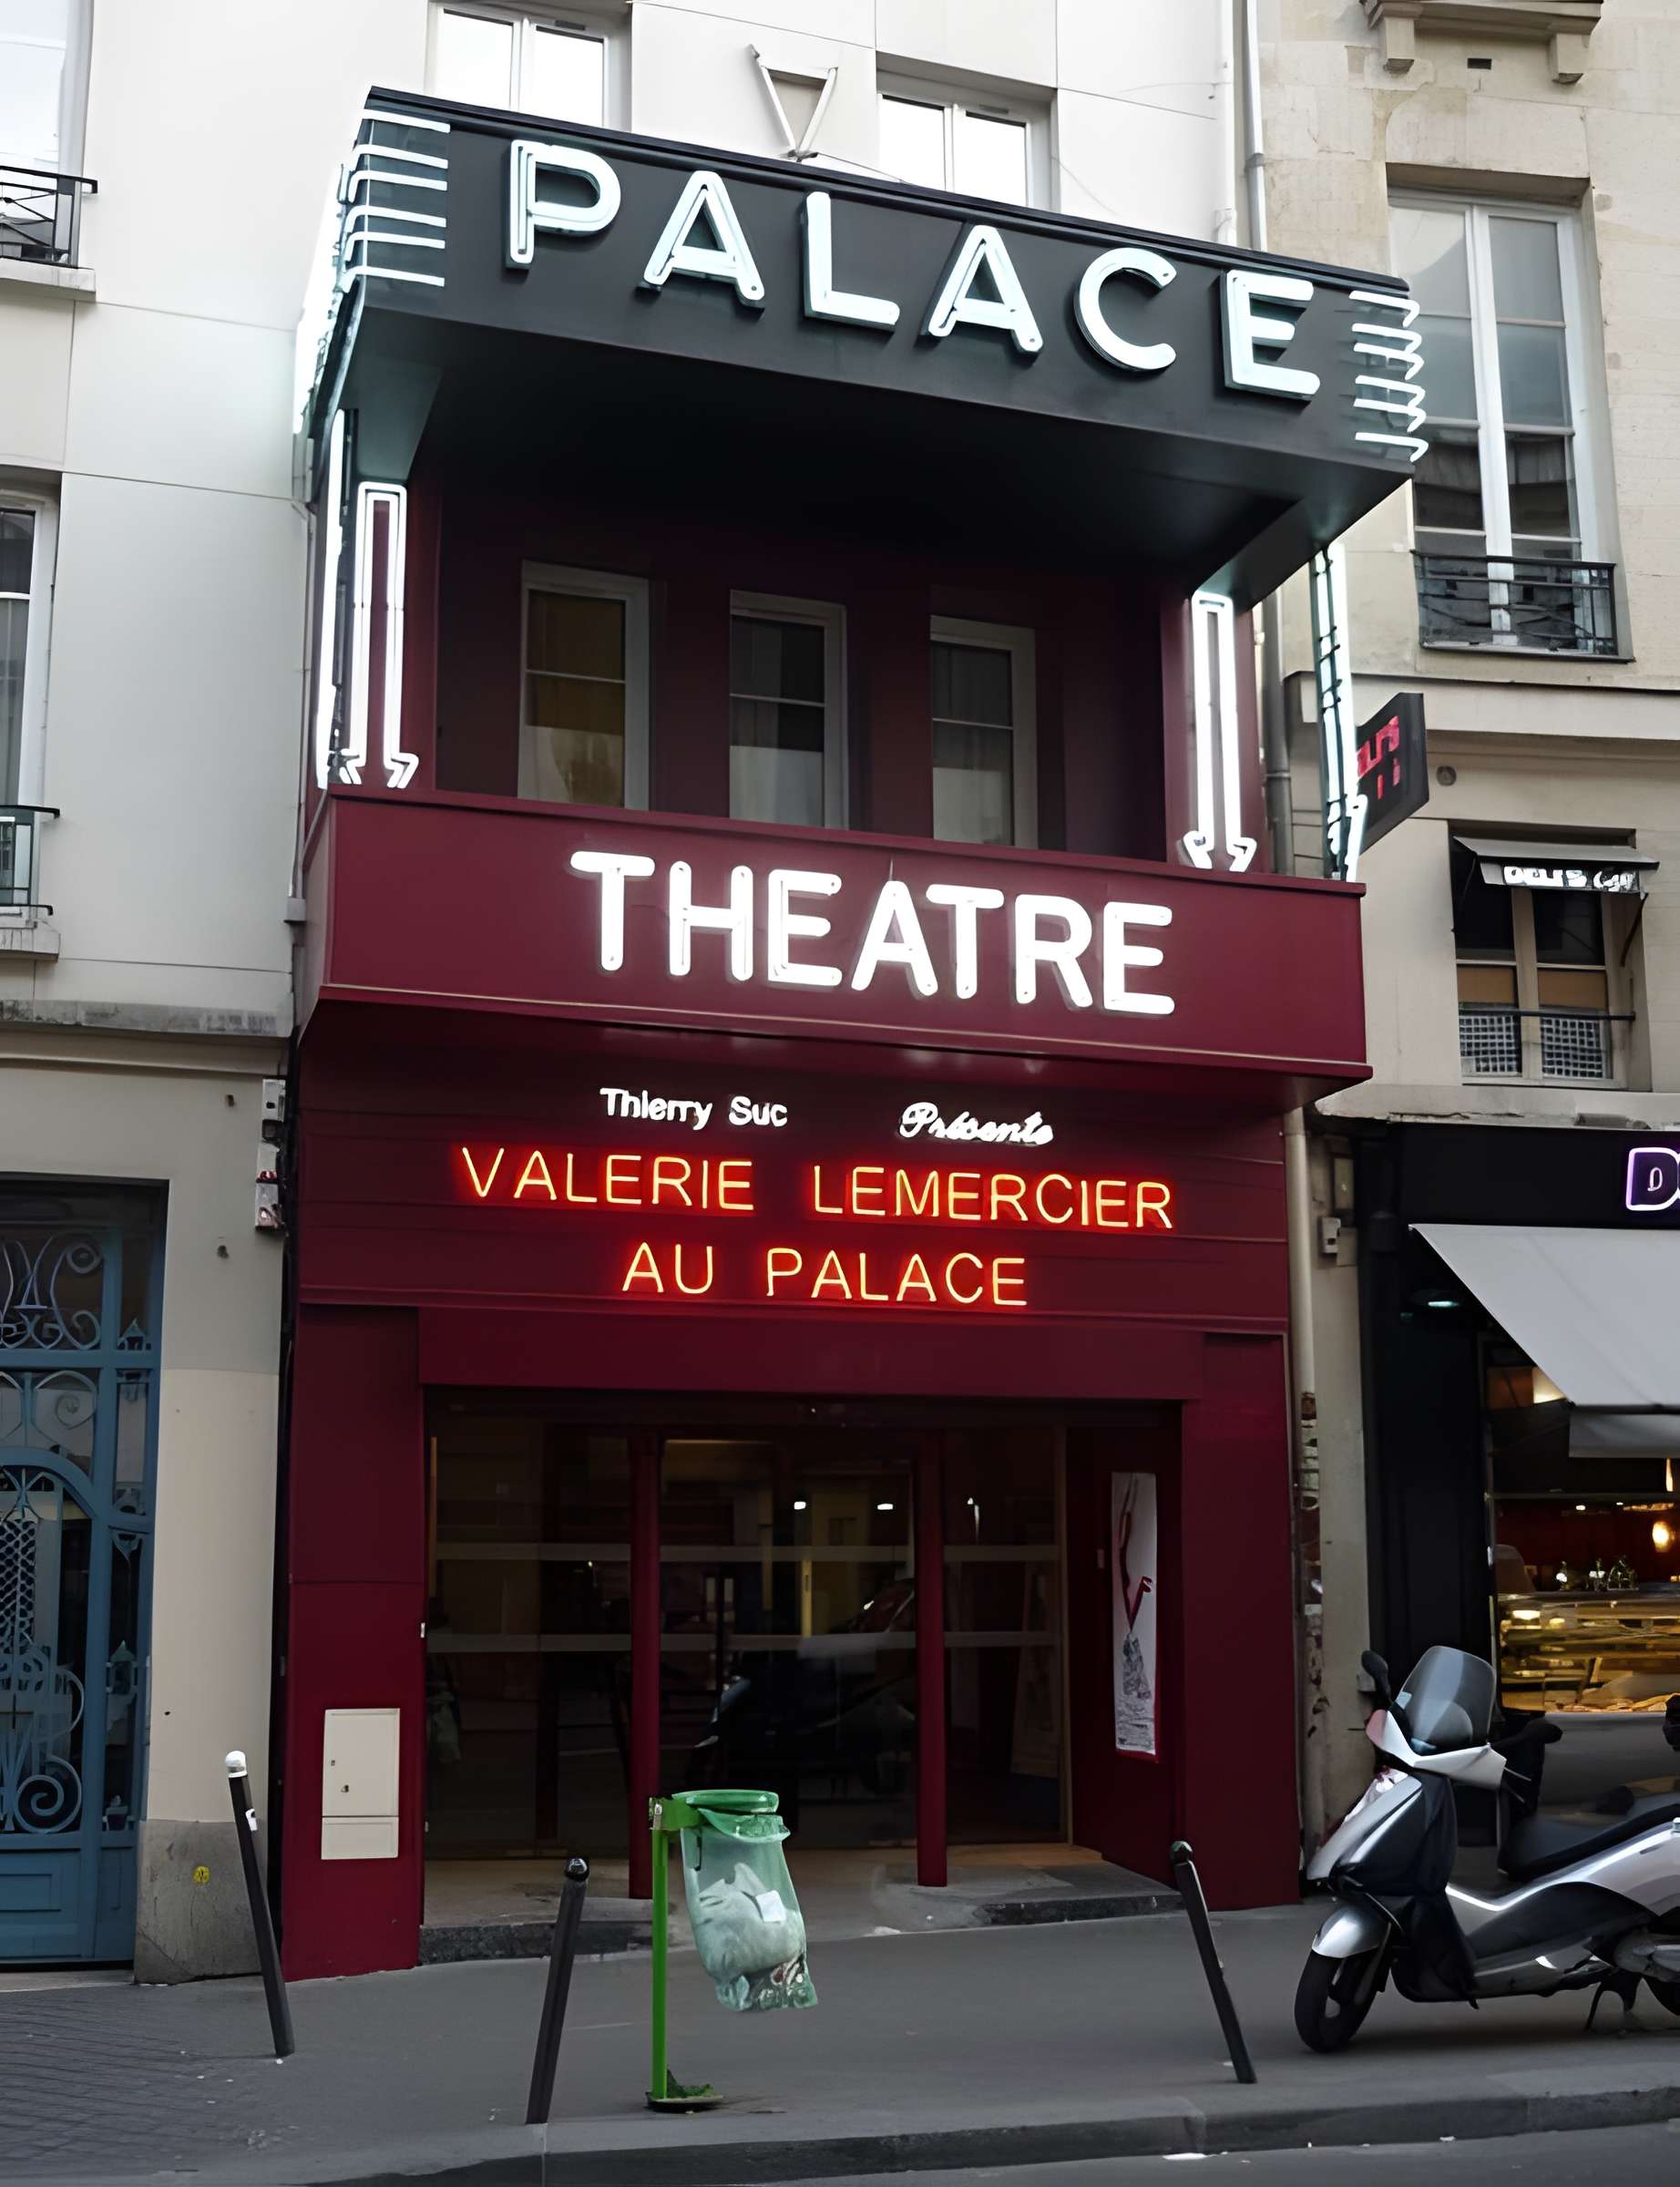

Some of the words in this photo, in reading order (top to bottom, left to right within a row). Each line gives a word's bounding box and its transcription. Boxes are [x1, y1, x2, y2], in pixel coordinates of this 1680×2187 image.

[508, 139, 1321, 399] PALACE
[569, 850, 1175, 1015] THEATRE
[599, 1087, 713, 1131] Thierry
[728, 1095, 788, 1127] Suc
[461, 1147, 754, 1212] VALERIE
[813, 1165, 1173, 1230] LEMERCIER
[1625, 1146, 1680, 1211] D
[621, 1242, 714, 1295] AU
[766, 1248, 1028, 1307] PALACE
